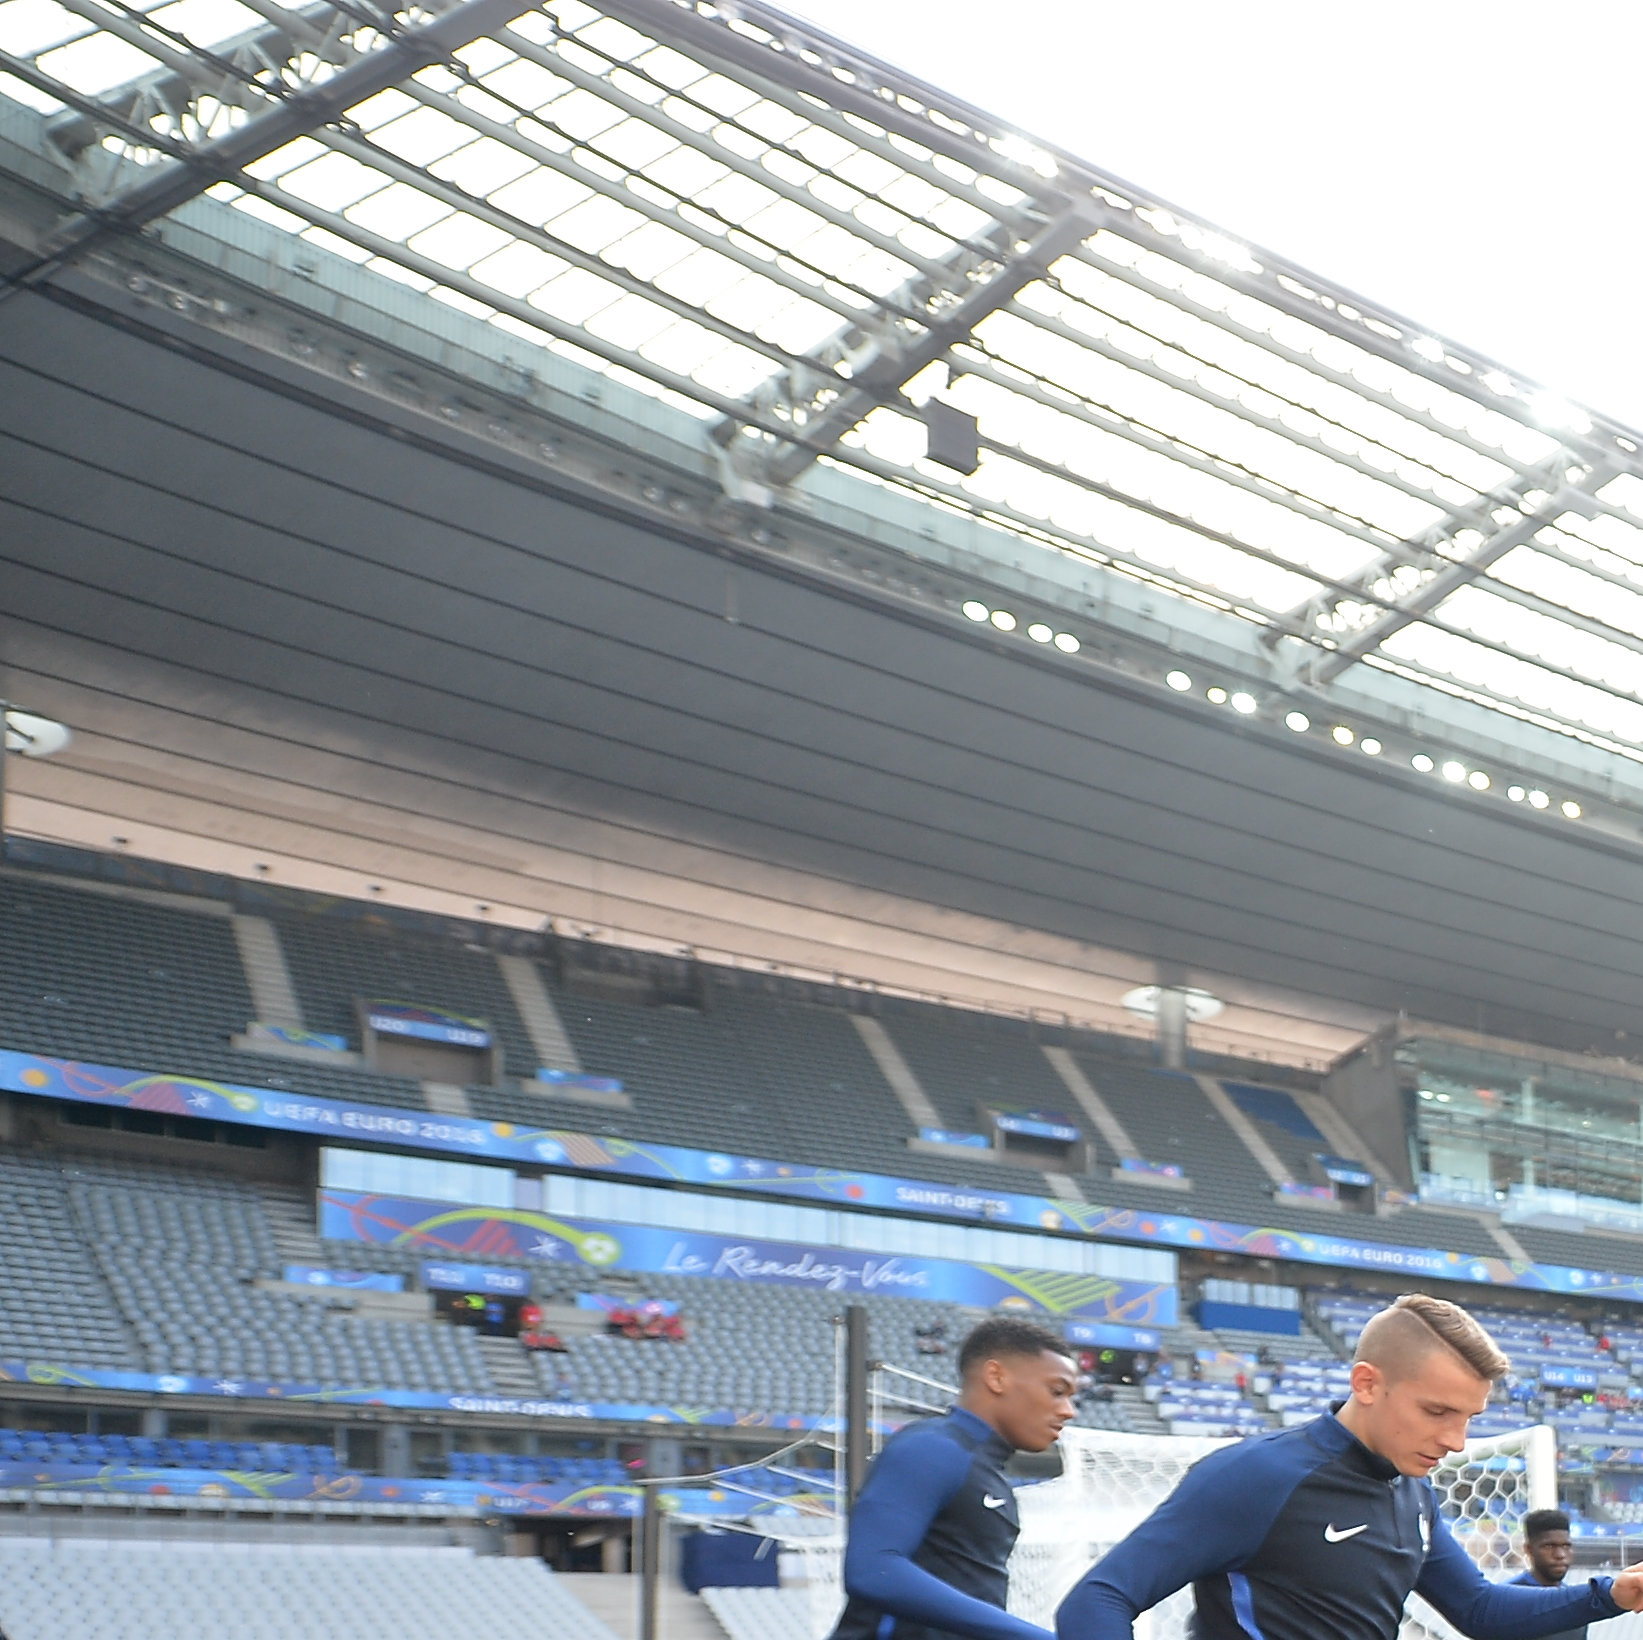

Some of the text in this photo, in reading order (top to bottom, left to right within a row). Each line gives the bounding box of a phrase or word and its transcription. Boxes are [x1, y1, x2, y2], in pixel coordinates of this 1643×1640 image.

[263, 1101, 486, 1146] UEFA EURO 2016
[662, 1243, 930, 1291] Le Rendez-Vous
[1319, 1243, 1443, 1269] UEFA EURO 2016
[448, 1396, 593, 1418] SAINT-DENIS
